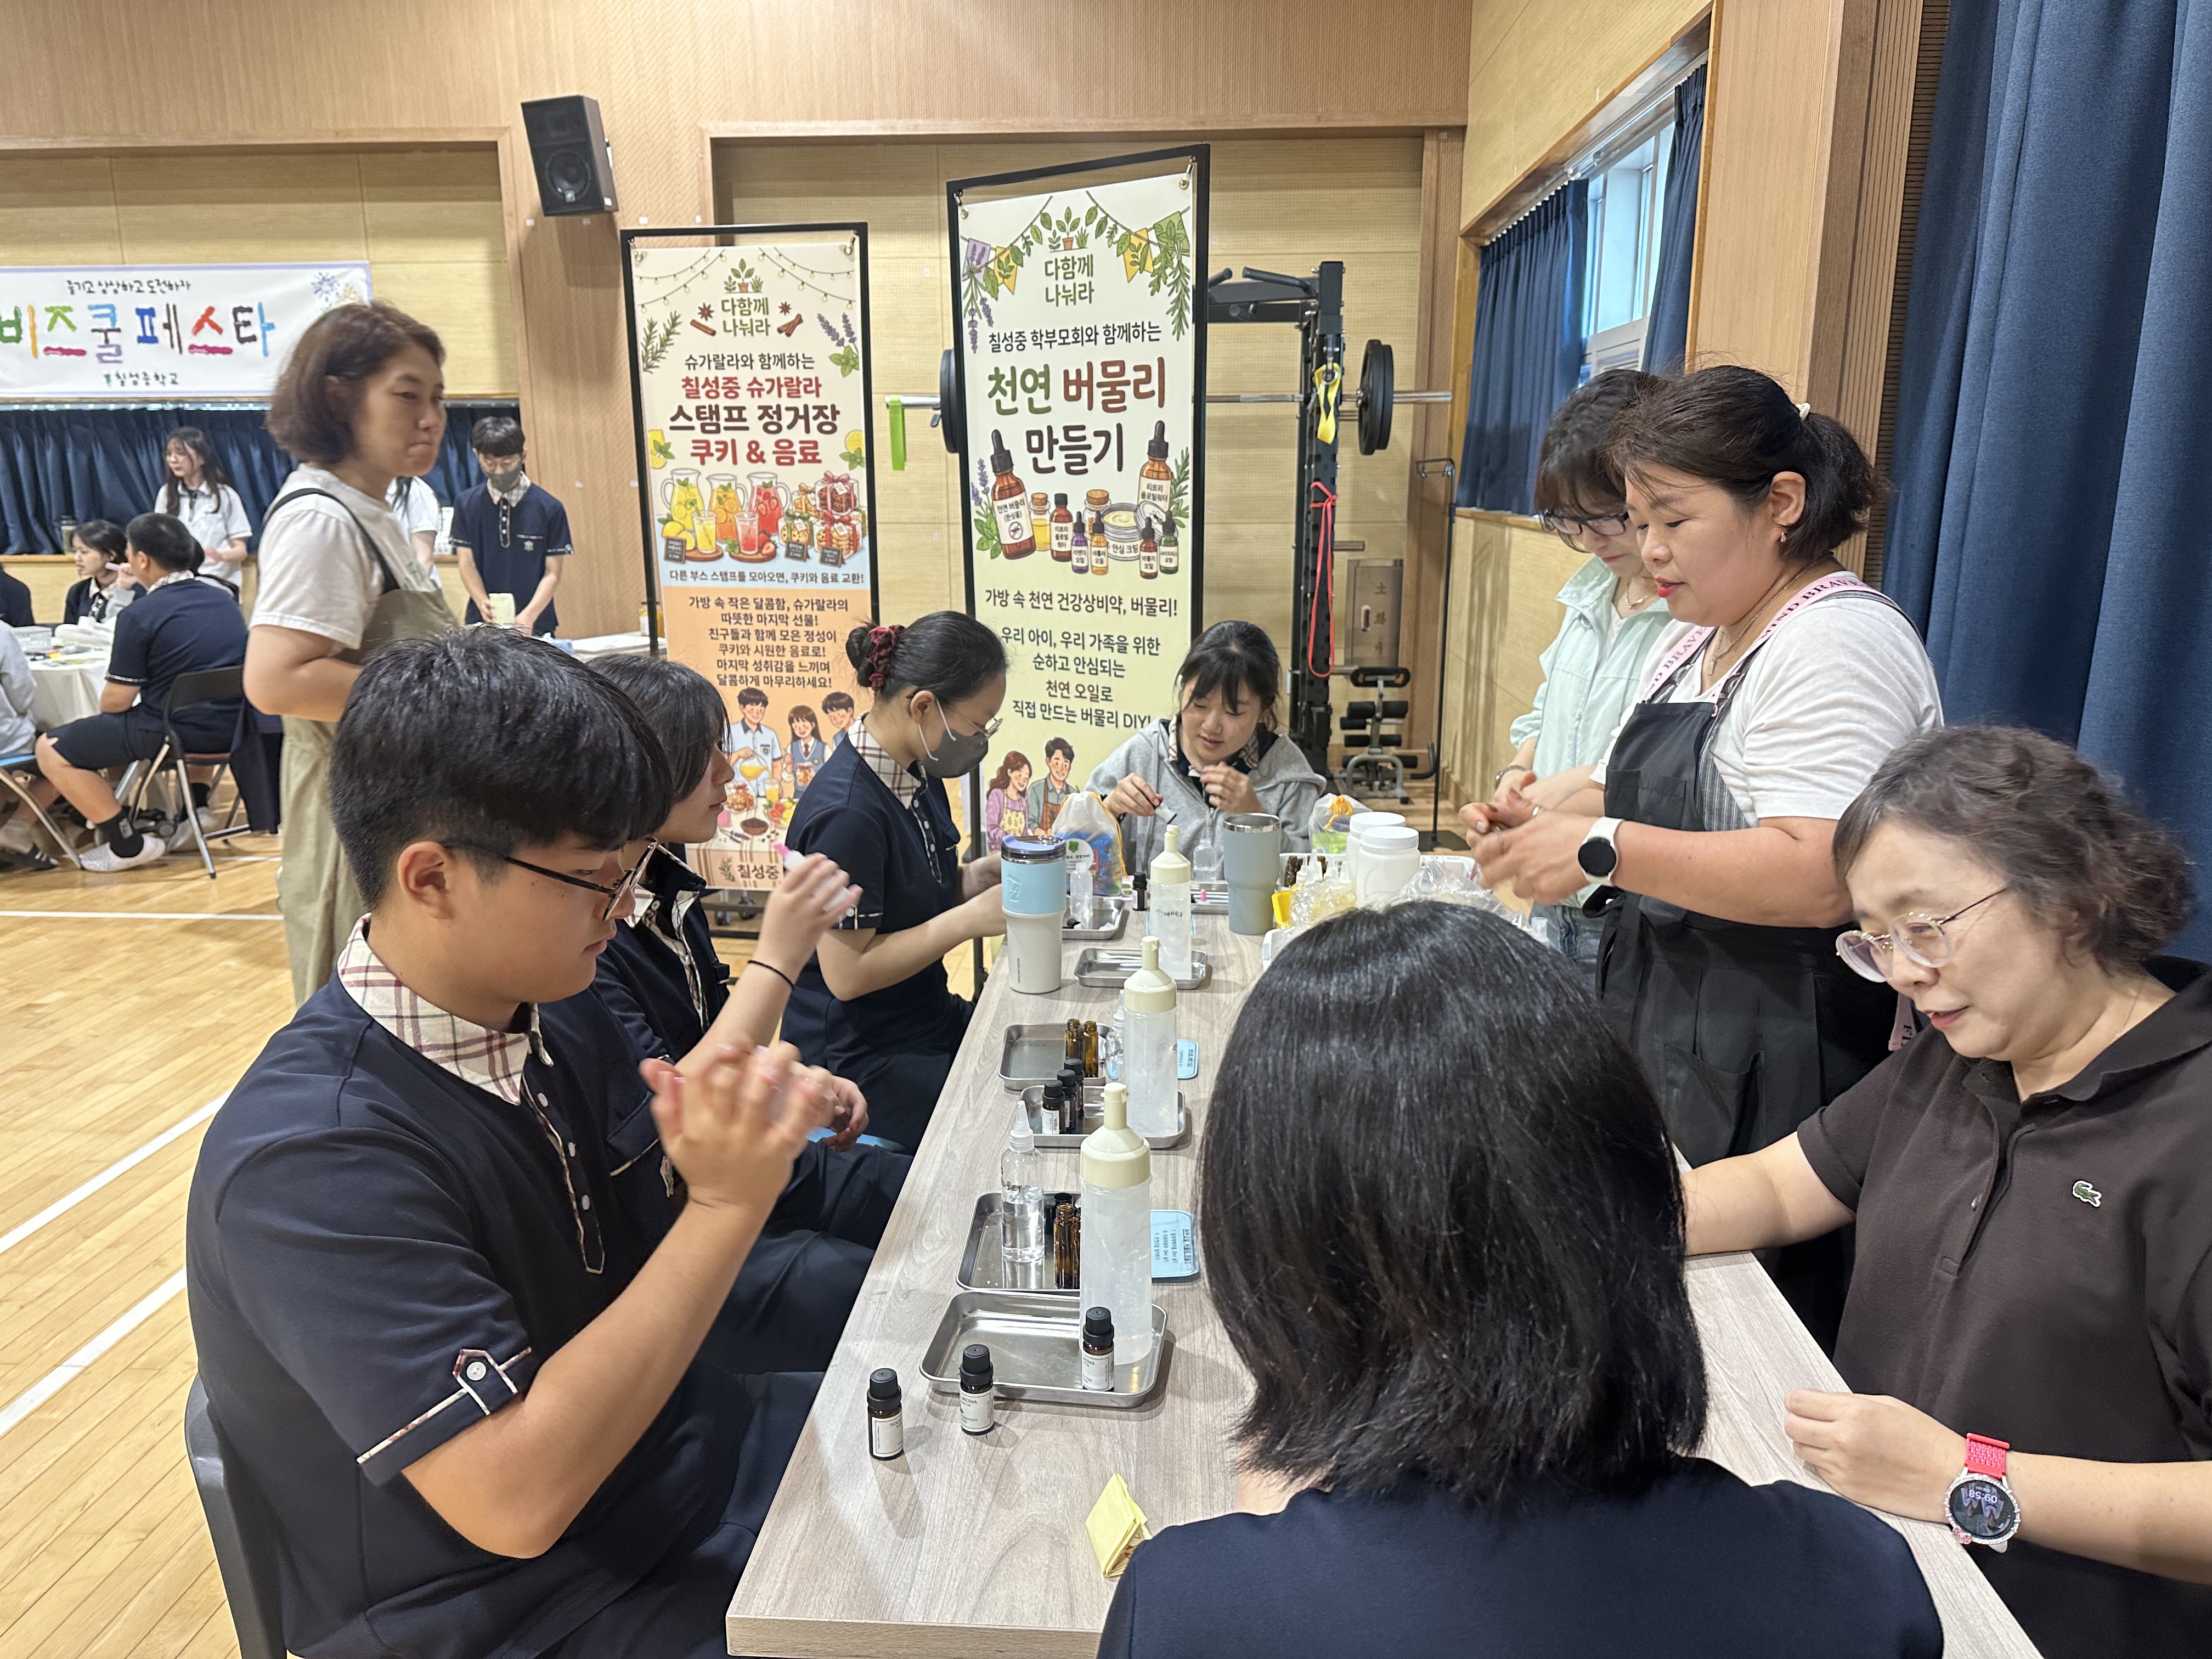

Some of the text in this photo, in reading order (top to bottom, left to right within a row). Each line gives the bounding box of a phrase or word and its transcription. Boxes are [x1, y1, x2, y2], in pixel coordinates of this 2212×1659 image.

[1045, 253, 1094, 281] 다함께
[98, 280, 144, 295] 상상하고
[147, 279, 191, 295] 도전하자
[1045, 281, 1094, 307] 나눠라
[721, 297, 769, 316] 다함께
[135, 302, 275, 357] 페스타
[723, 318, 771, 337] 나눠라
[989, 321, 1161, 353] 칠성중 학부모회와 함께하는
[685, 353, 815, 370] 슈가랄라와 함께하는
[681, 376, 822, 399] 칠성중 슈가랄라
[988, 357, 1165, 416] 천연 버물리
[669, 404, 840, 435] 스탬프 정거장
[690, 438, 822, 466] 쿠키 & 음료
[1026, 422, 1124, 476] 만들기
[1112, 545, 1125, 554] 안심
[670, 570, 865, 584] 다른 부스 스탬프를 모아오면, 쿠키와 음료 교환!
[689, 596, 848, 612] 가방 속 작은 달콤함, 슈가랄라의
[985, 589, 1177, 617] 가방 속 천연 건강상비약, 버물리!
[721, 613, 819, 627] 따뜻한 마지막 선물!
[1760, 602, 1799, 639] MIND
[708, 628, 837, 642] 친구들과 함께 모은 정성이
[1001, 627, 1161, 656] 우리 아이, 우리 가족을 위한
[718, 644, 826, 658] 쿠키와 시원한 음료로!
[1663, 626, 1707, 670] BRAVE
[716, 659, 830, 674] 마지막 성취감을 느끼며
[1032, 653, 1126, 678] 순하고 안심되는
[716, 674, 832, 689] 달콤하게 마무리하세요!
[1046, 680, 1113, 703] 천연 오일로
[1012, 699, 1036, 719] 직접
[1040, 702, 1077, 723] 만드는
[1081, 707, 1119, 729] 버물리
[1968, 1489, 1997, 1503] 09:58
